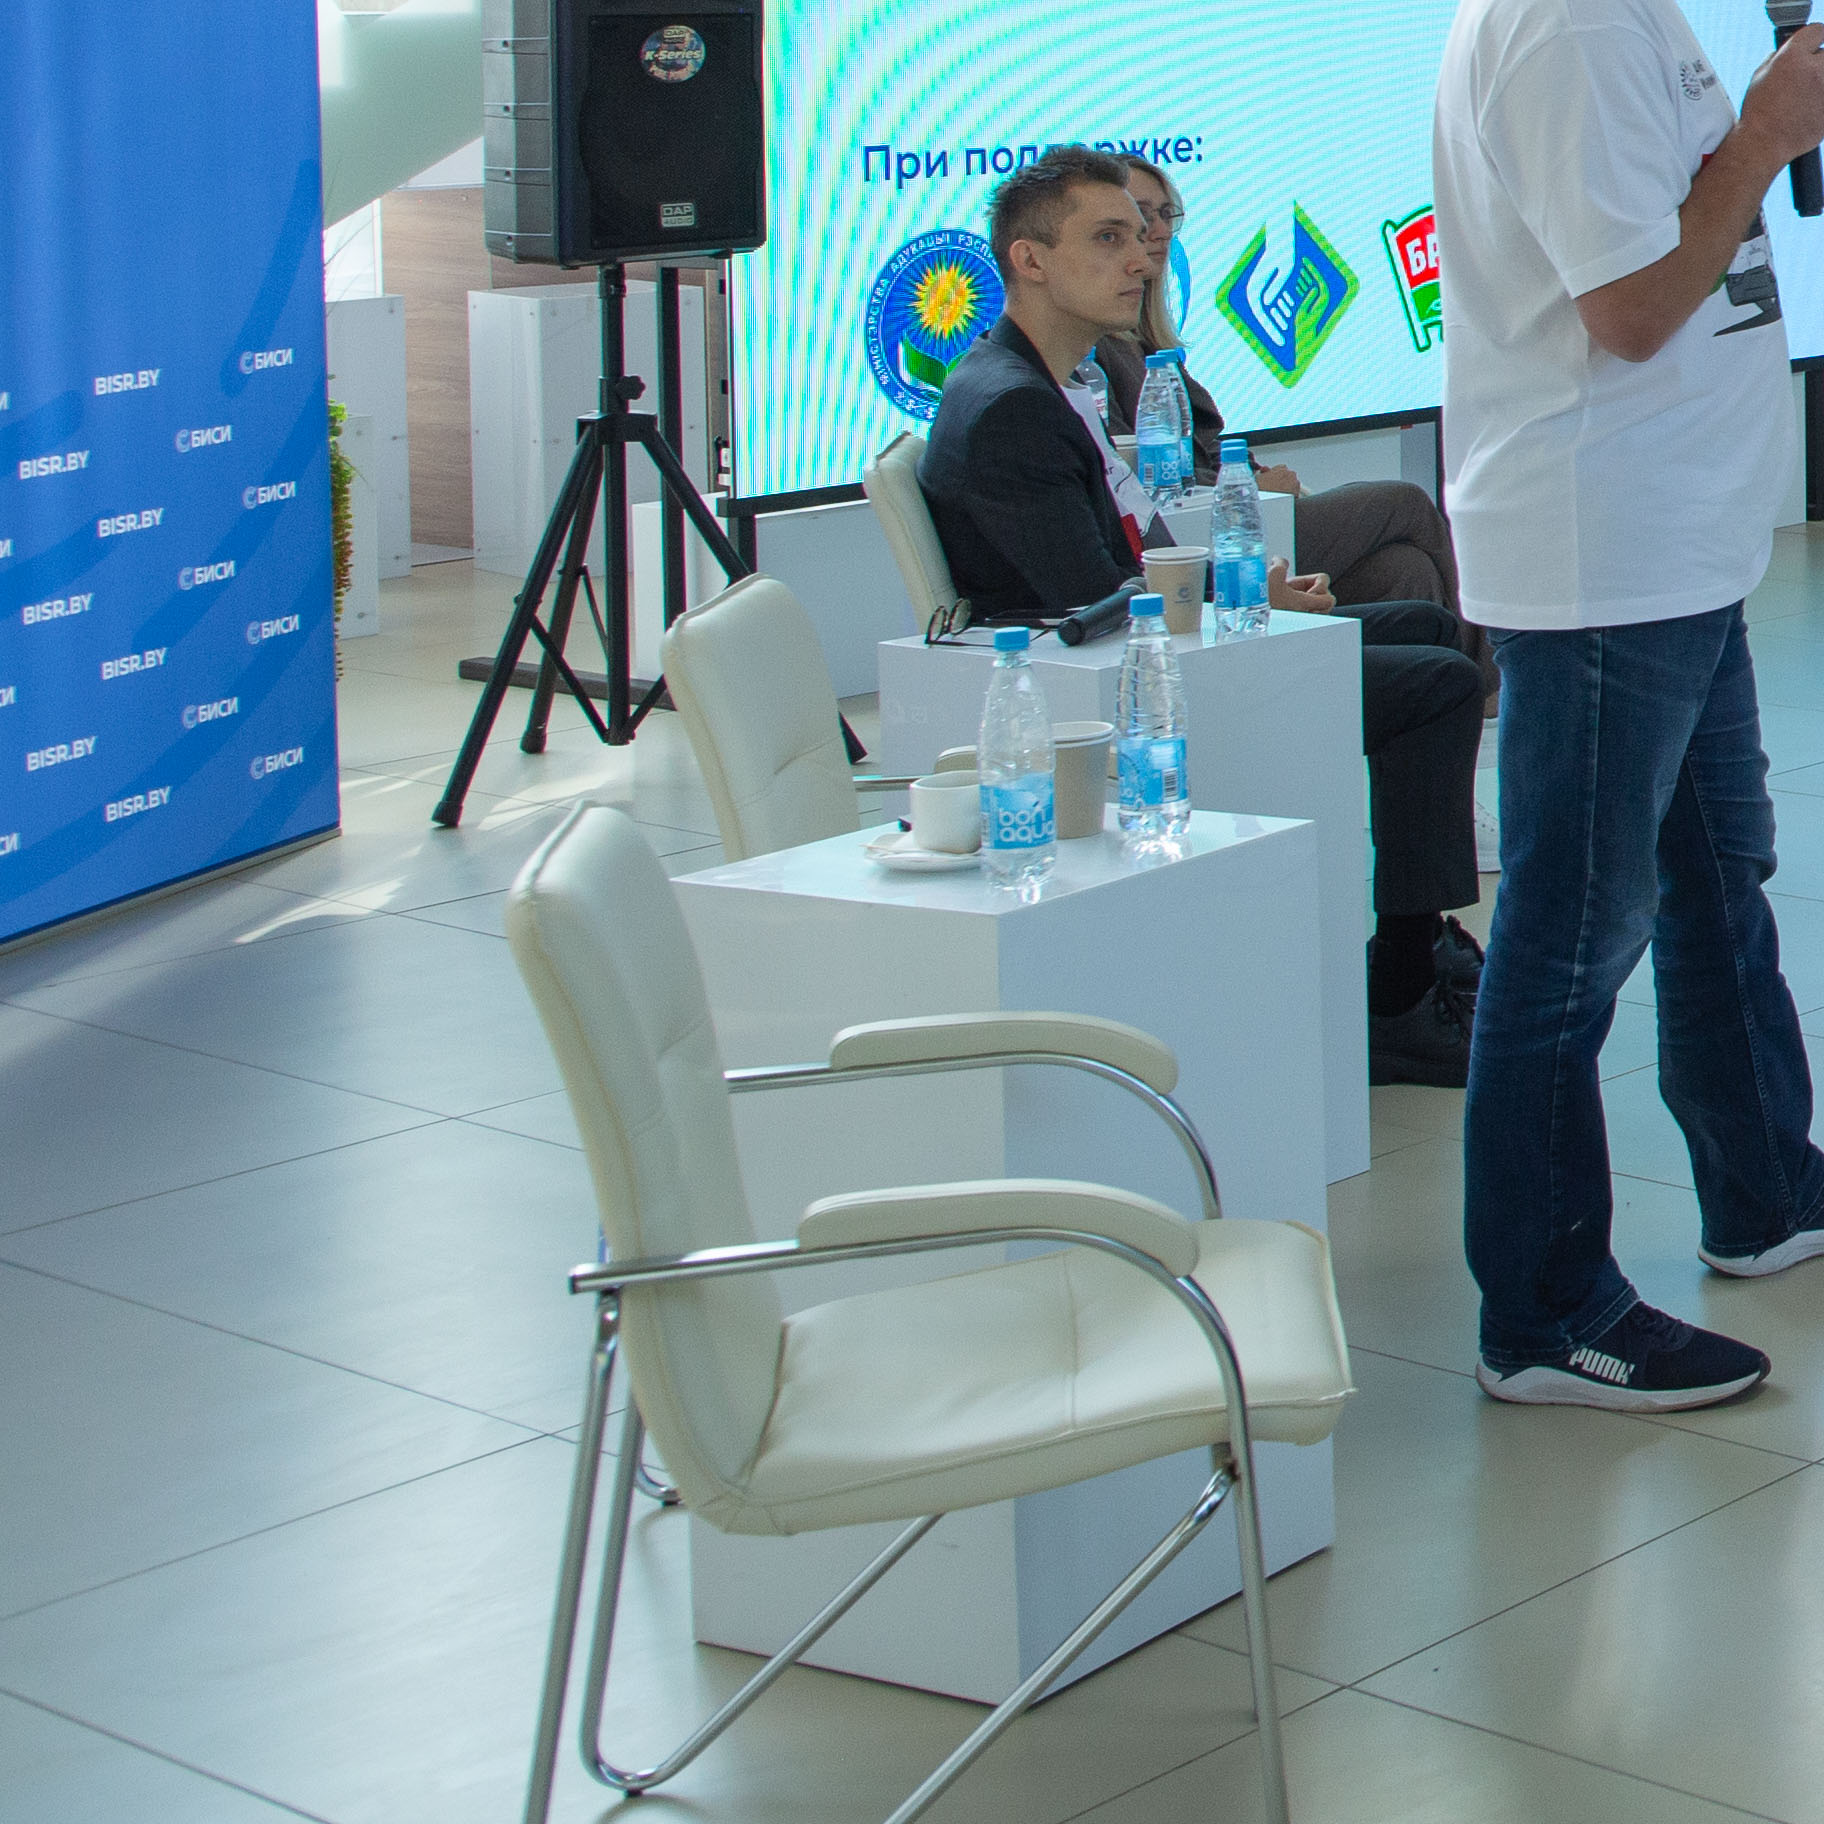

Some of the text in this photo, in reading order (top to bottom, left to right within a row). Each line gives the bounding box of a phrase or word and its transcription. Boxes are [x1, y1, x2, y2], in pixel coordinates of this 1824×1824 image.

[864, 144, 948, 189] При
[663, 205, 692, 216] DAP
[254, 348, 293, 371] БИСИ
[94, 368, 160, 396] BISR.BY
[191, 424, 232, 449] БИСИ
[18, 450, 90, 480] BISR.BY
[257, 481, 296, 505] БИСИ
[98, 507, 164, 538] BISR.BY
[194, 560, 235, 586] БИСИ
[22, 593, 94, 626] BISR.BY
[261, 614, 300, 639] БИСИ
[101, 648, 167, 681] BISR.BY
[198, 697, 239, 724] БИСИ
[26, 736, 98, 772] BISR.BY
[265, 747, 304, 774] БИСИ
[104, 786, 171, 823] BISR.BY
[1569, 1347, 1635, 1385] PUMA
